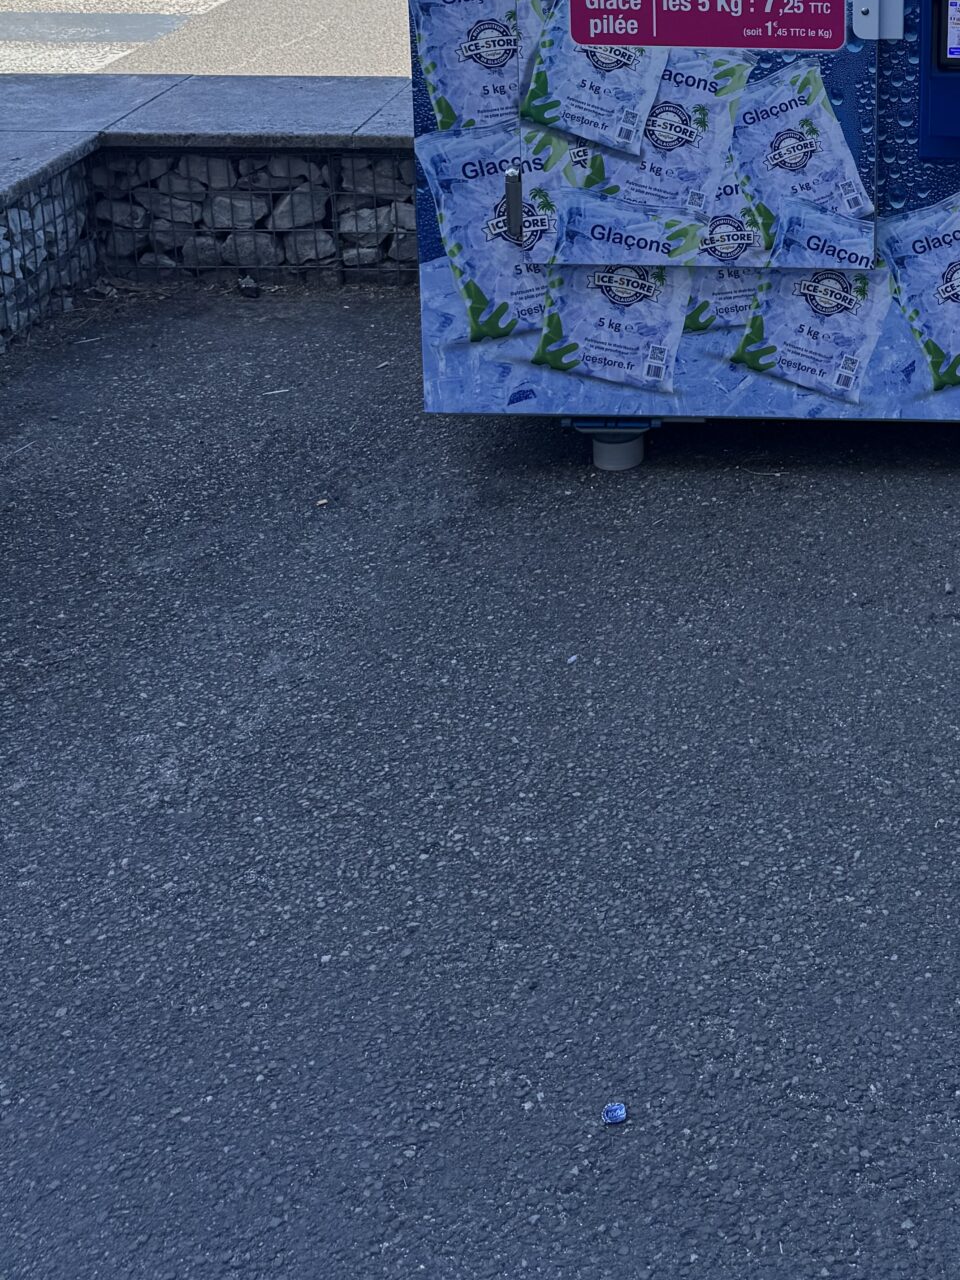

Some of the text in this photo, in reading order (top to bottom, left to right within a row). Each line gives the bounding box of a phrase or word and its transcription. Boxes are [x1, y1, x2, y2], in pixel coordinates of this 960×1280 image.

[808, 2, 831, 14] TTC
[589, 13, 639, 38] pilée
[743, 27, 762, 37] (soit
[790, 28, 806, 37] TTC
[808, 28, 816, 37] le
[818, 28, 833, 39] Kg)
[482, 83, 507, 96] 5 kg
[580, 79, 602, 94] 5 kg
[661, 68, 719, 94] açons
[742, 94, 808, 126] Glaçons
[646, 118, 696, 140] CE-STORE
[769, 140, 816, 163] ICE-STORE
[590, 223, 672, 255] Glaçons
[701, 233, 753, 247] ICE-STORE
[597, 273, 654, 294] ICE-STORE
[802, 282, 855, 306] ICE-STORE
